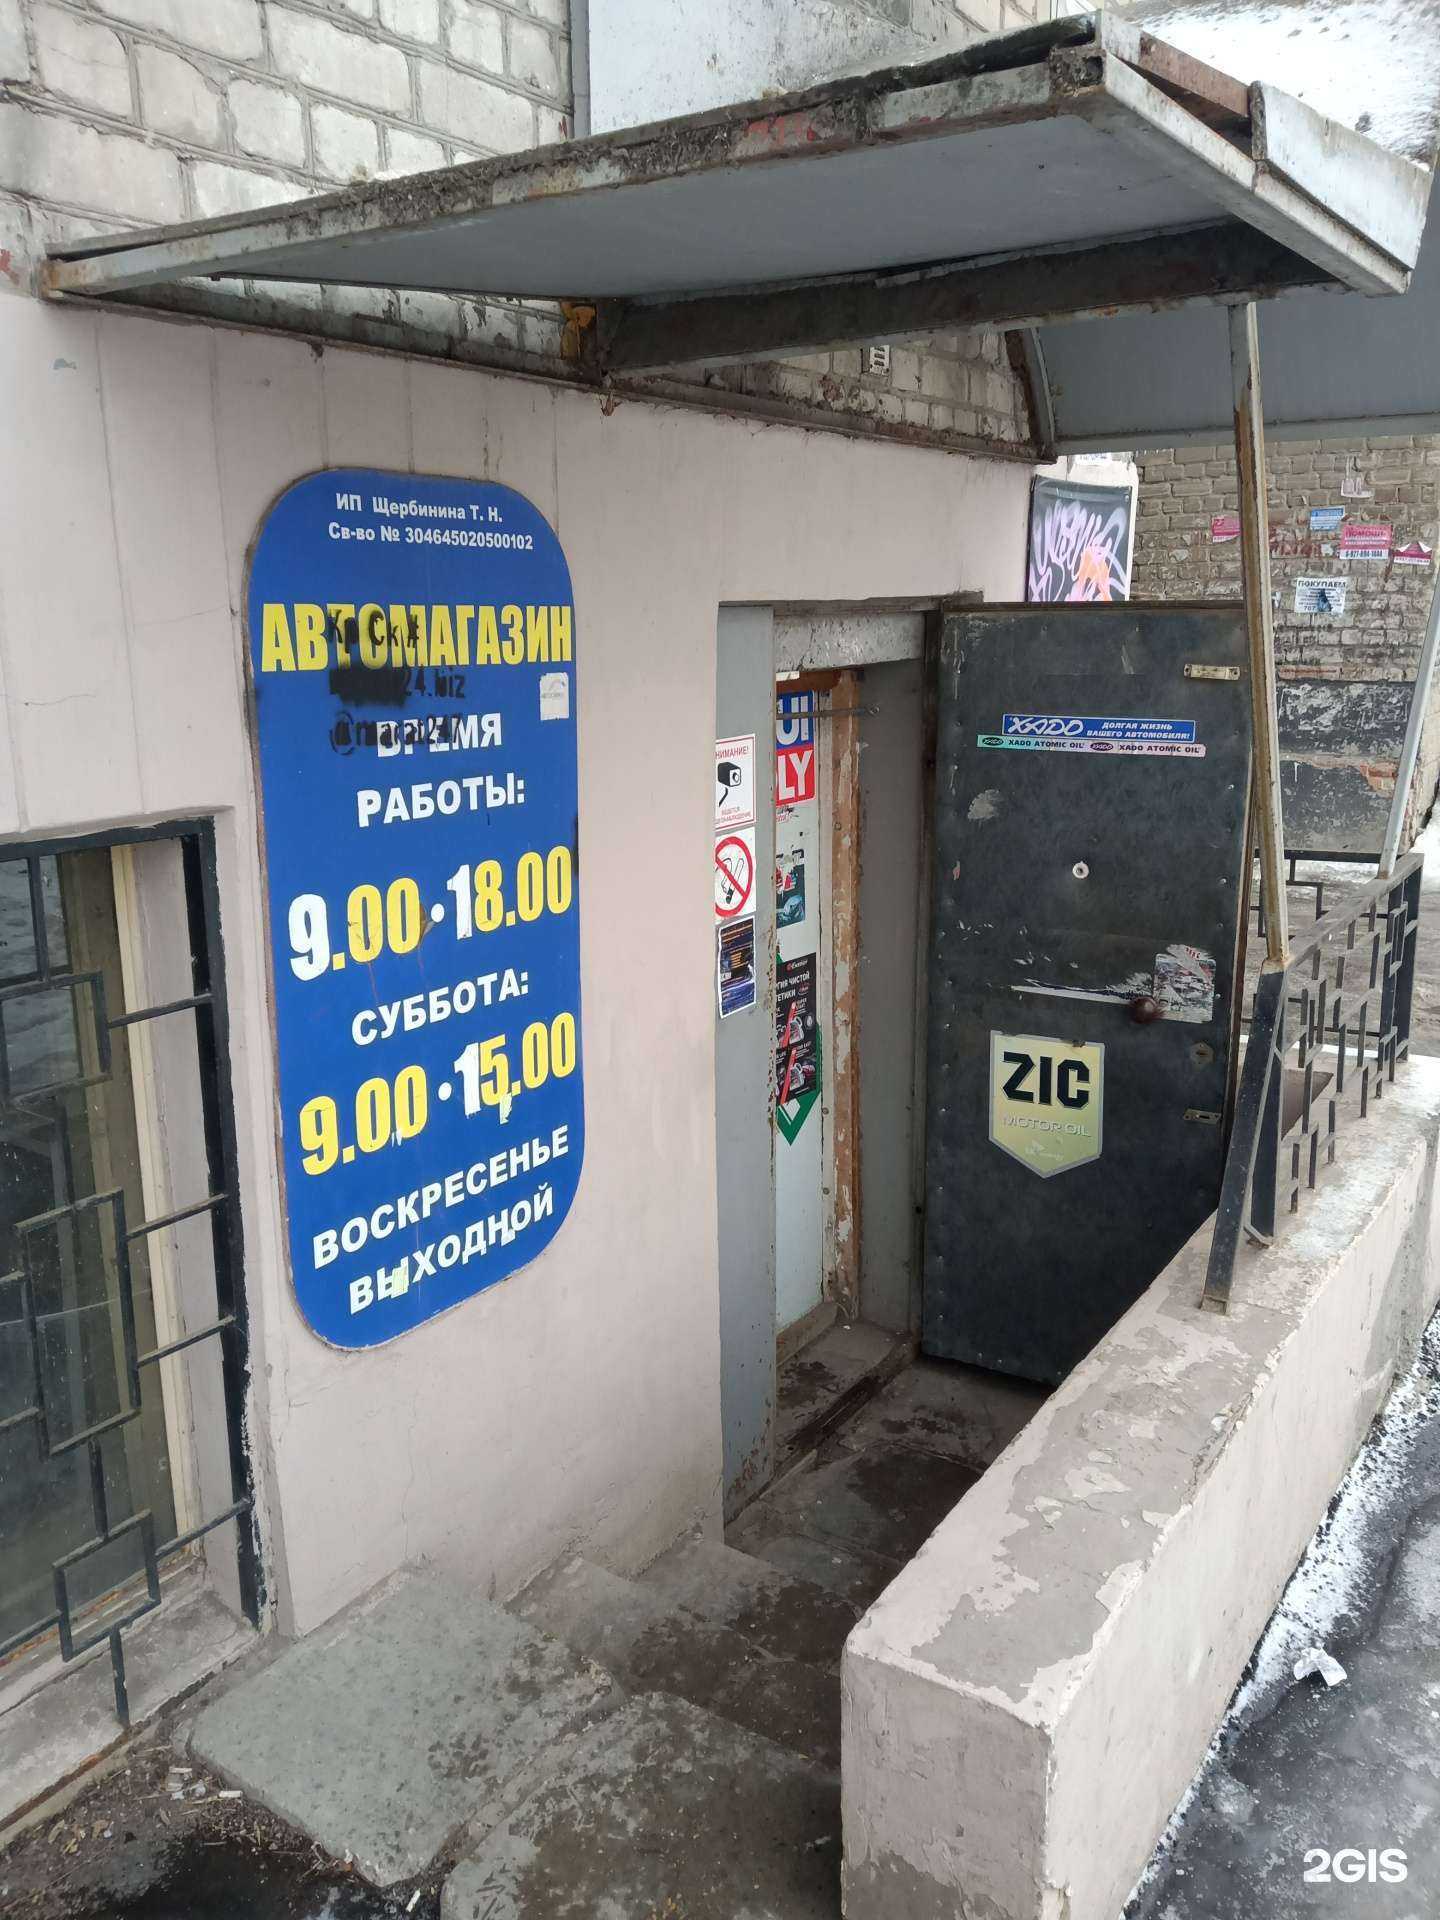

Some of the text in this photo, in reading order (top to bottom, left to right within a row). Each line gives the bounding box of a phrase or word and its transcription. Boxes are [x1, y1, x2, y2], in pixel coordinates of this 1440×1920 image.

[336, 493, 503, 522] ИП Щербинина Т. Н.
[328, 522, 533, 550] Св-во № 304645020500102
[262, 603, 573, 672] АВТОМАГАЗИН
[376, 712, 502, 757] ВРЕМЯ
[776, 696, 810, 745] UI
[1008, 717, 1084, 736] XADO
[1086, 730, 1190, 739] ВАШЕГО АВТОМОБИЛЯ!
[1102, 722, 1138, 730] ДОЛГАЯ
[715, 746, 749, 759] НИМАНИЕ!
[1034, 740, 1069, 748] ATOMIC
[776, 749, 814, 800] LY
[356, 772, 526, 828] РАБОТЫ:
[351, 968, 529, 1046] СУББОТА:
[1002, 1051, 1091, 1110] ZIC
[1003, 1114, 1092, 1137] MOTOR OIL
[313, 1124, 569, 1270] ВОСКРЕСЕНЬЕ
[349, 1183, 554, 1314] ВЫХОДНОЙ
